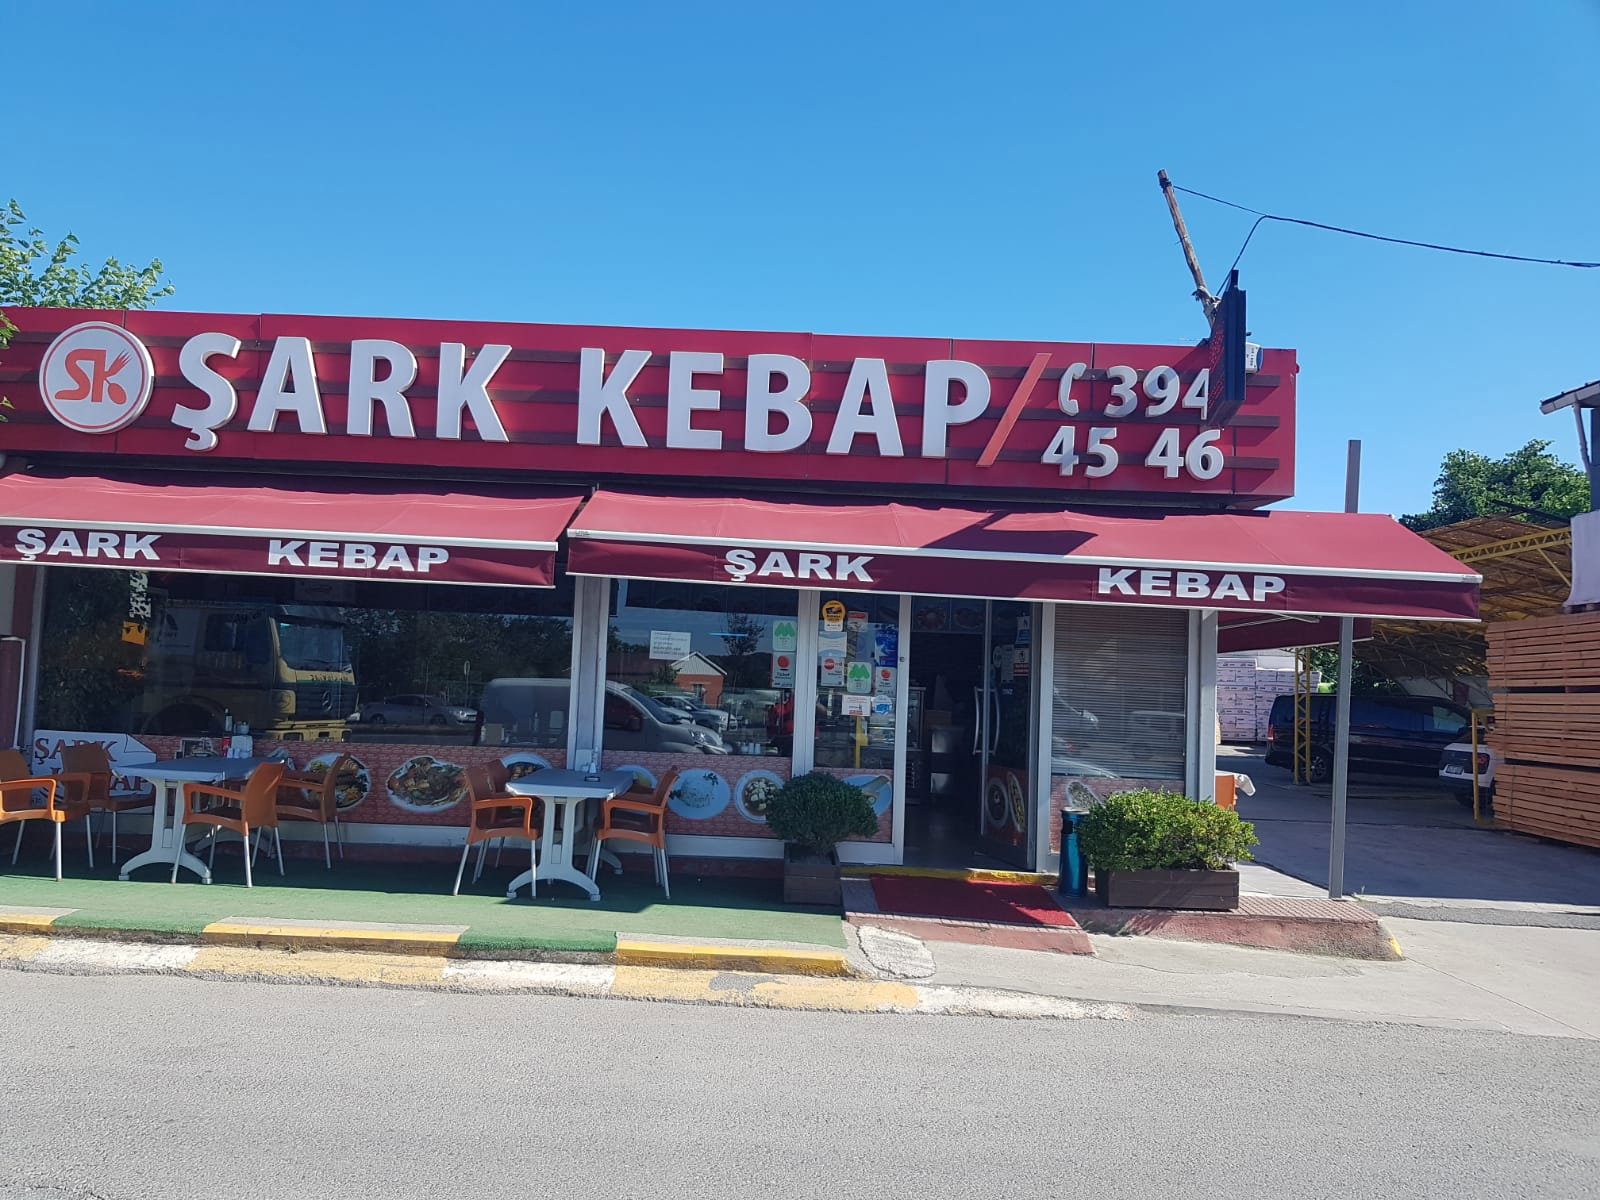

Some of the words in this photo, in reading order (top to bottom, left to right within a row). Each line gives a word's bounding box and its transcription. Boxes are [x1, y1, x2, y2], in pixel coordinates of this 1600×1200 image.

[171, 332, 513, 452] ŞARK
[576, 347, 991, 459] KEBAP
[1103, 365, 1210, 420] 394
[1041, 425, 1119, 477] 45
[1145, 428, 1225, 481] 46
[14, 528, 162, 562] ŞARK
[266, 539, 451, 574] KEBAP
[723, 549, 875, 582] ŞARK
[1096, 568, 1287, 603] KEBAP
